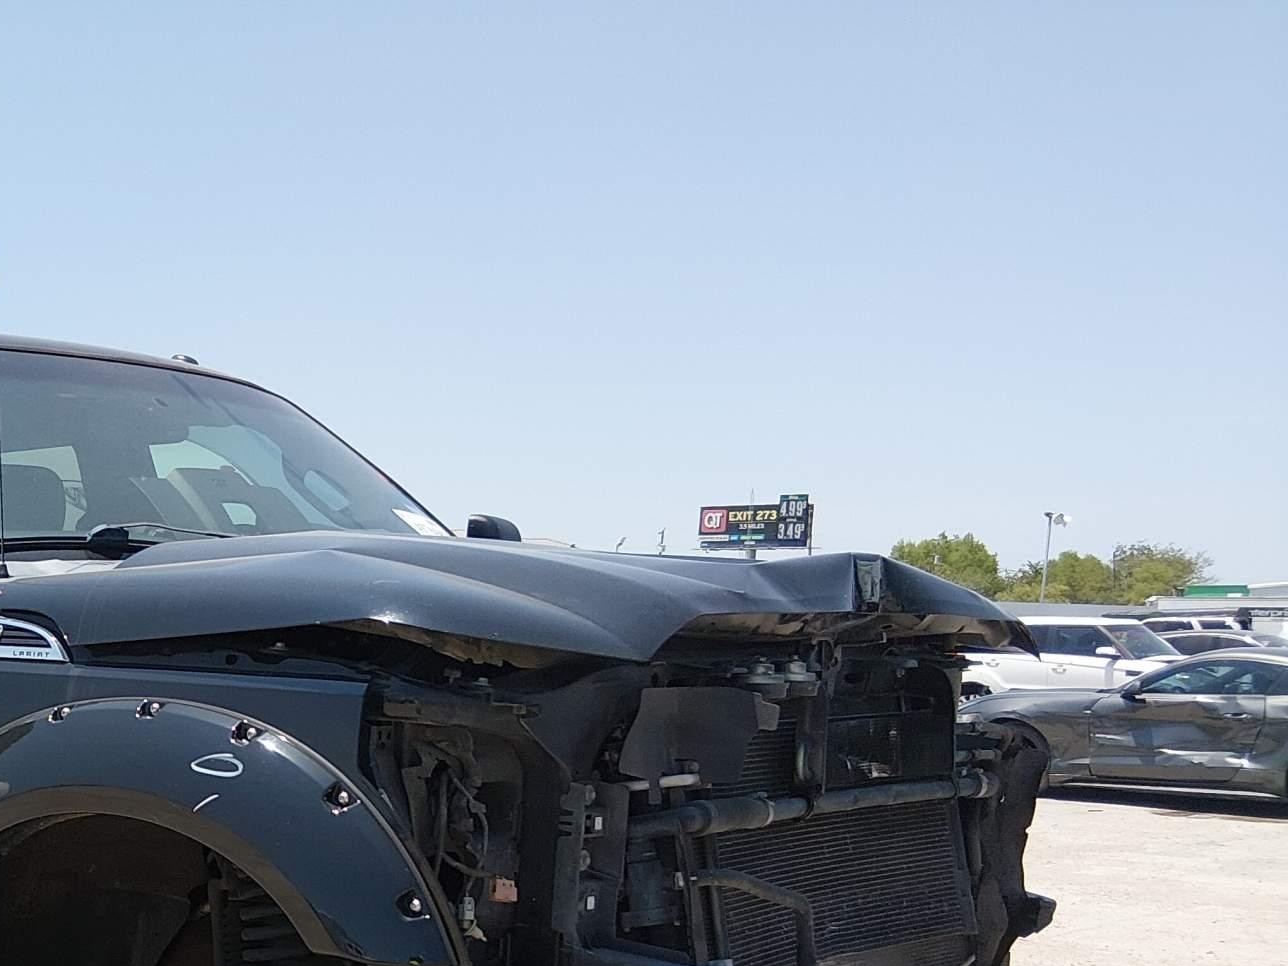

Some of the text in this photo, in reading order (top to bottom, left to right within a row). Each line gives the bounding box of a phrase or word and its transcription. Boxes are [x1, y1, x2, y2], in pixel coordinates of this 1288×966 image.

[704, 512, 723, 529] QT
[728, 511, 754, 521] EXIT
[755, 511, 777, 520] 273
[13, 650, 51, 658] LARIAT
